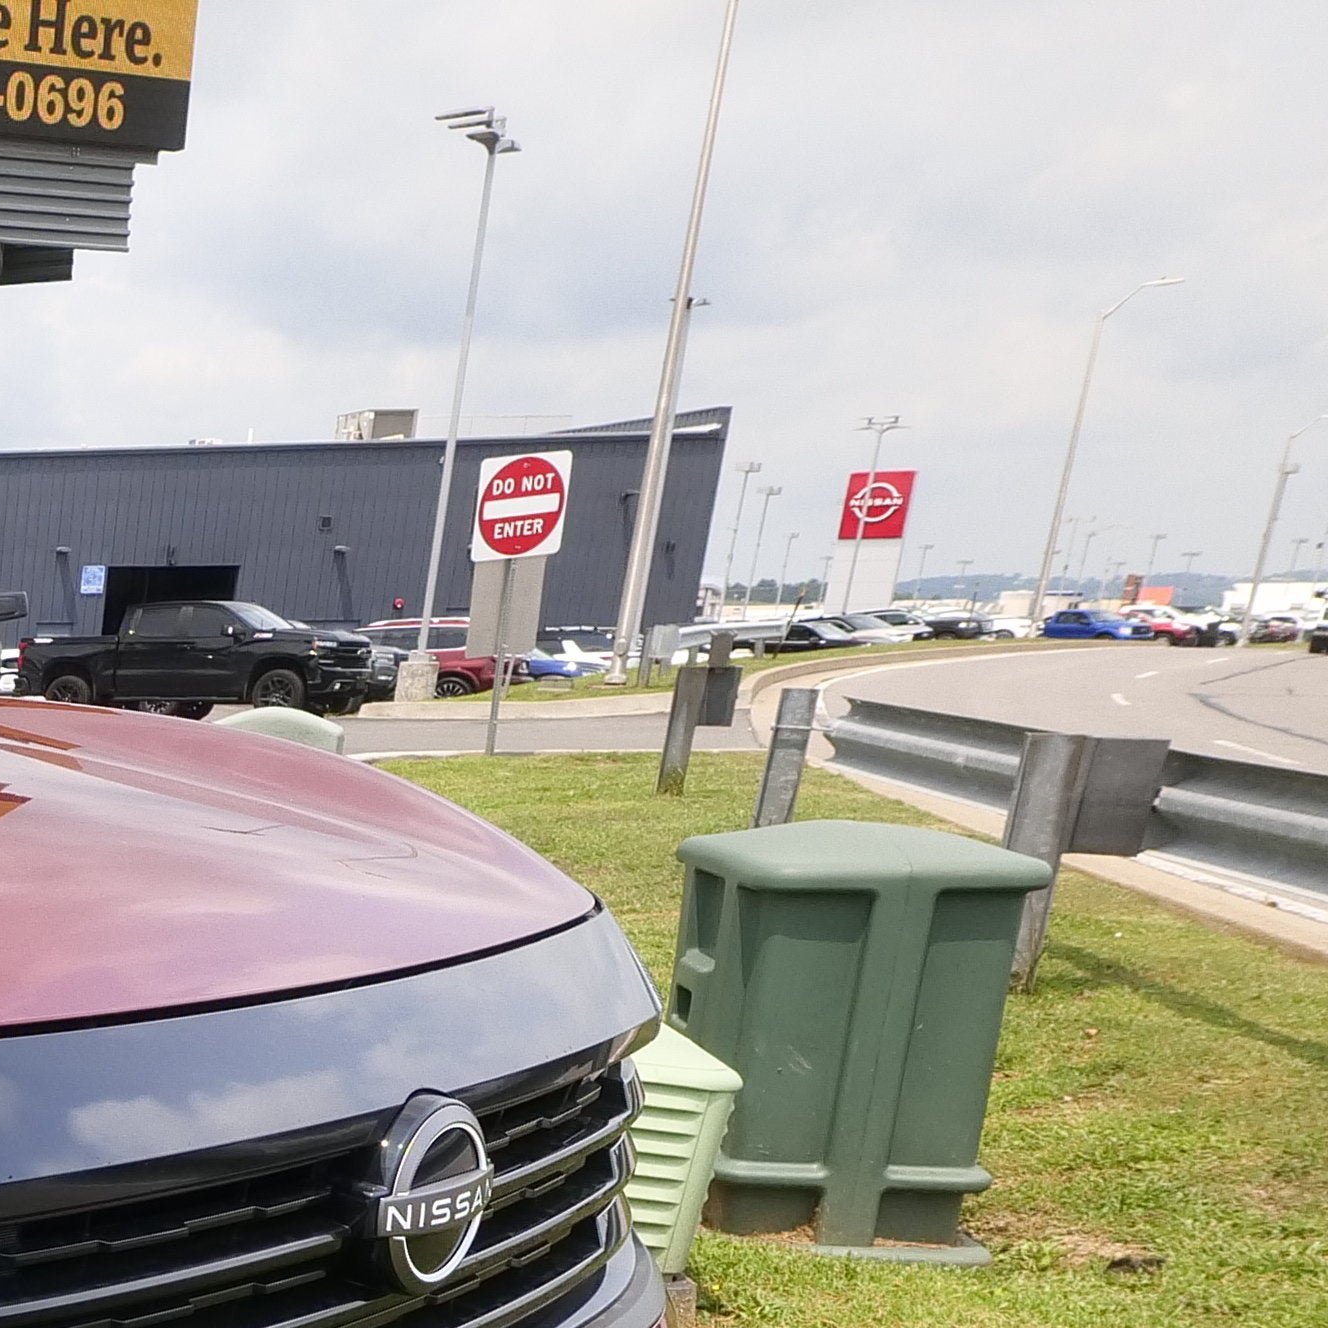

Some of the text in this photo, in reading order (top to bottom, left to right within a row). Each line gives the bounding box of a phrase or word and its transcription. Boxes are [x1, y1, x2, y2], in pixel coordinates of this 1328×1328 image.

[24, 0, 162, 68] Here.
[492, 472, 555, 496] DO NOT
[493, 518, 544, 540] ENTER
[385, 1177, 493, 1233] NISSAN
